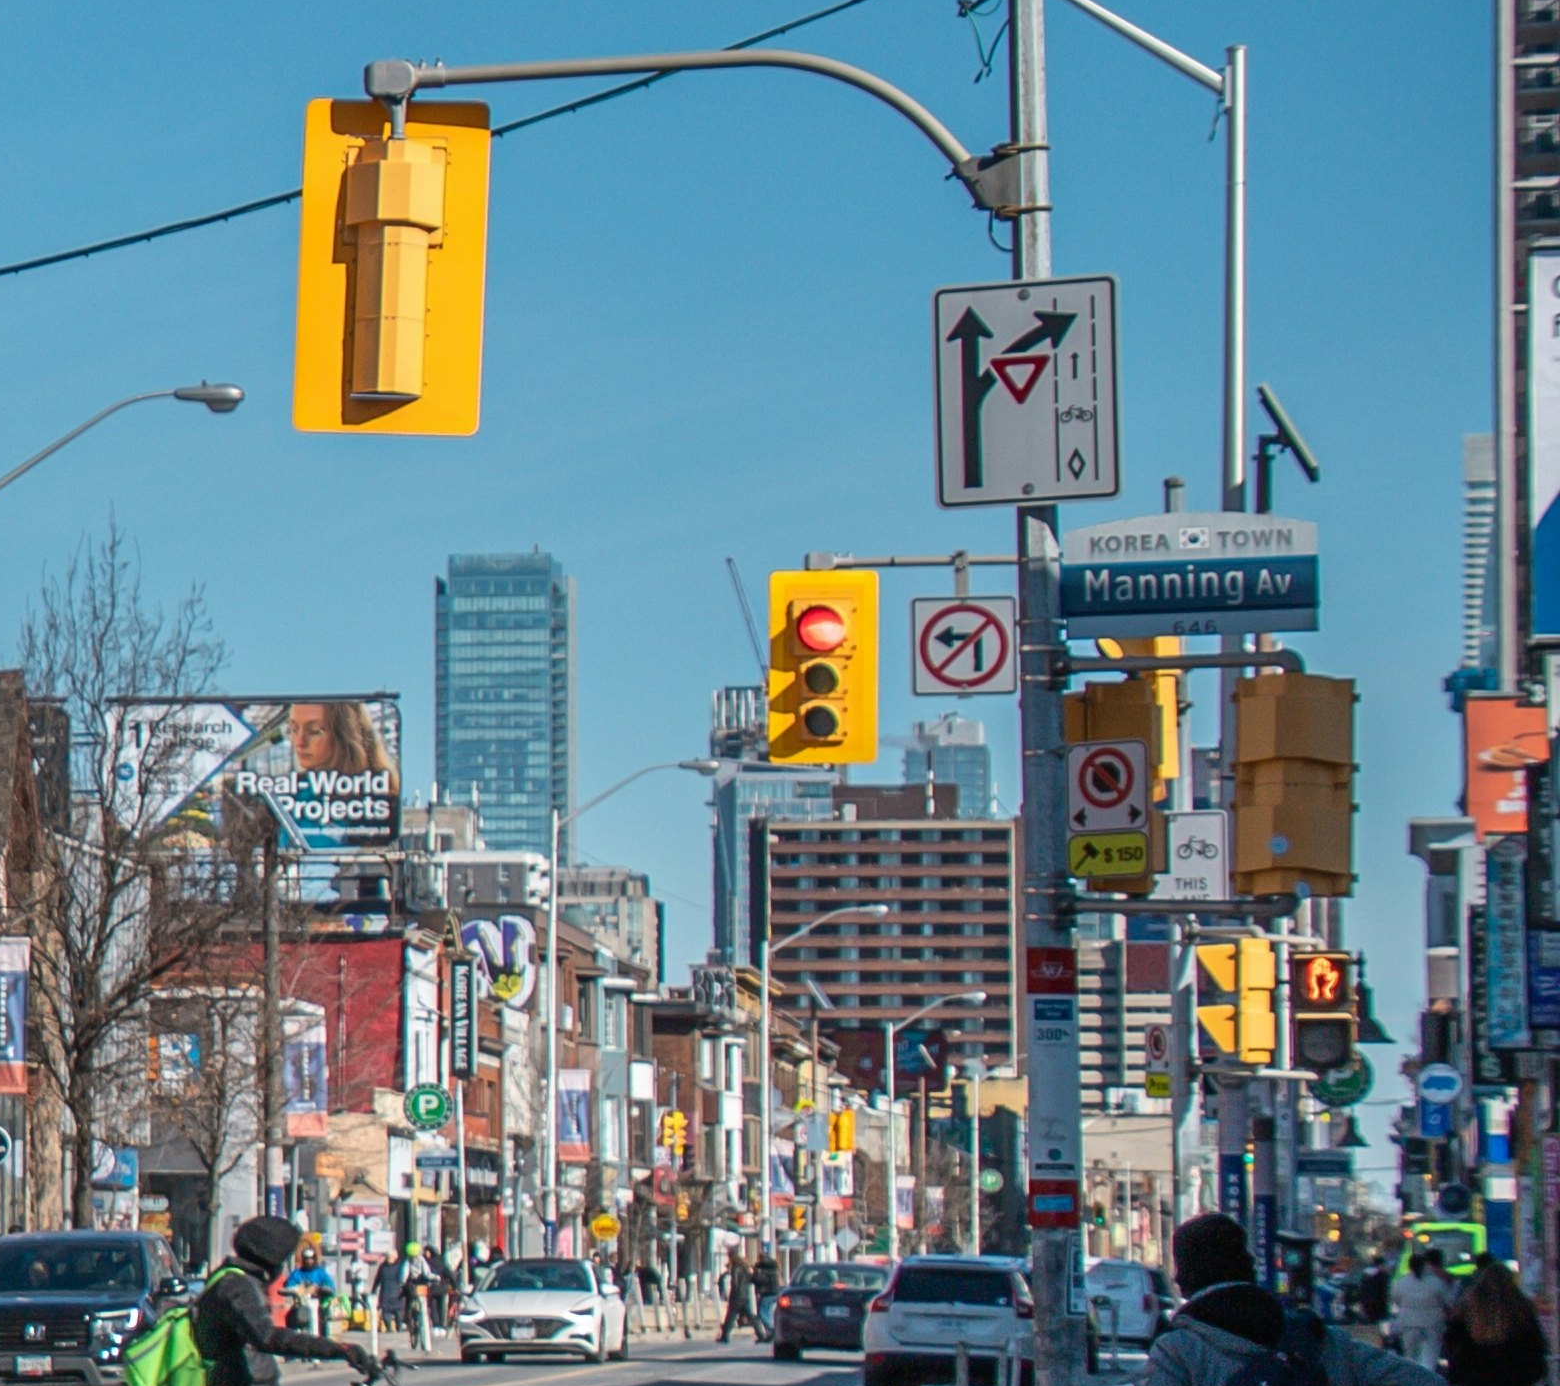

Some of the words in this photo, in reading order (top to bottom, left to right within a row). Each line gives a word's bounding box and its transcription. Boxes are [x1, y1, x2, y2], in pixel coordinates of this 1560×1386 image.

[1089, 533, 1171, 553] KOREA
[1217, 527, 1293, 548] TOWN
[1084, 564, 1245, 605] Manning
[1256, 567, 1293, 596] Av
[236, 770, 390, 795] Real-World
[279, 795, 391, 824] Projects
[1174, 877, 1208, 890] THIS
[453, 964, 470, 1019] KOREAN
[453, 1019, 470, 1071] VILLAGE
